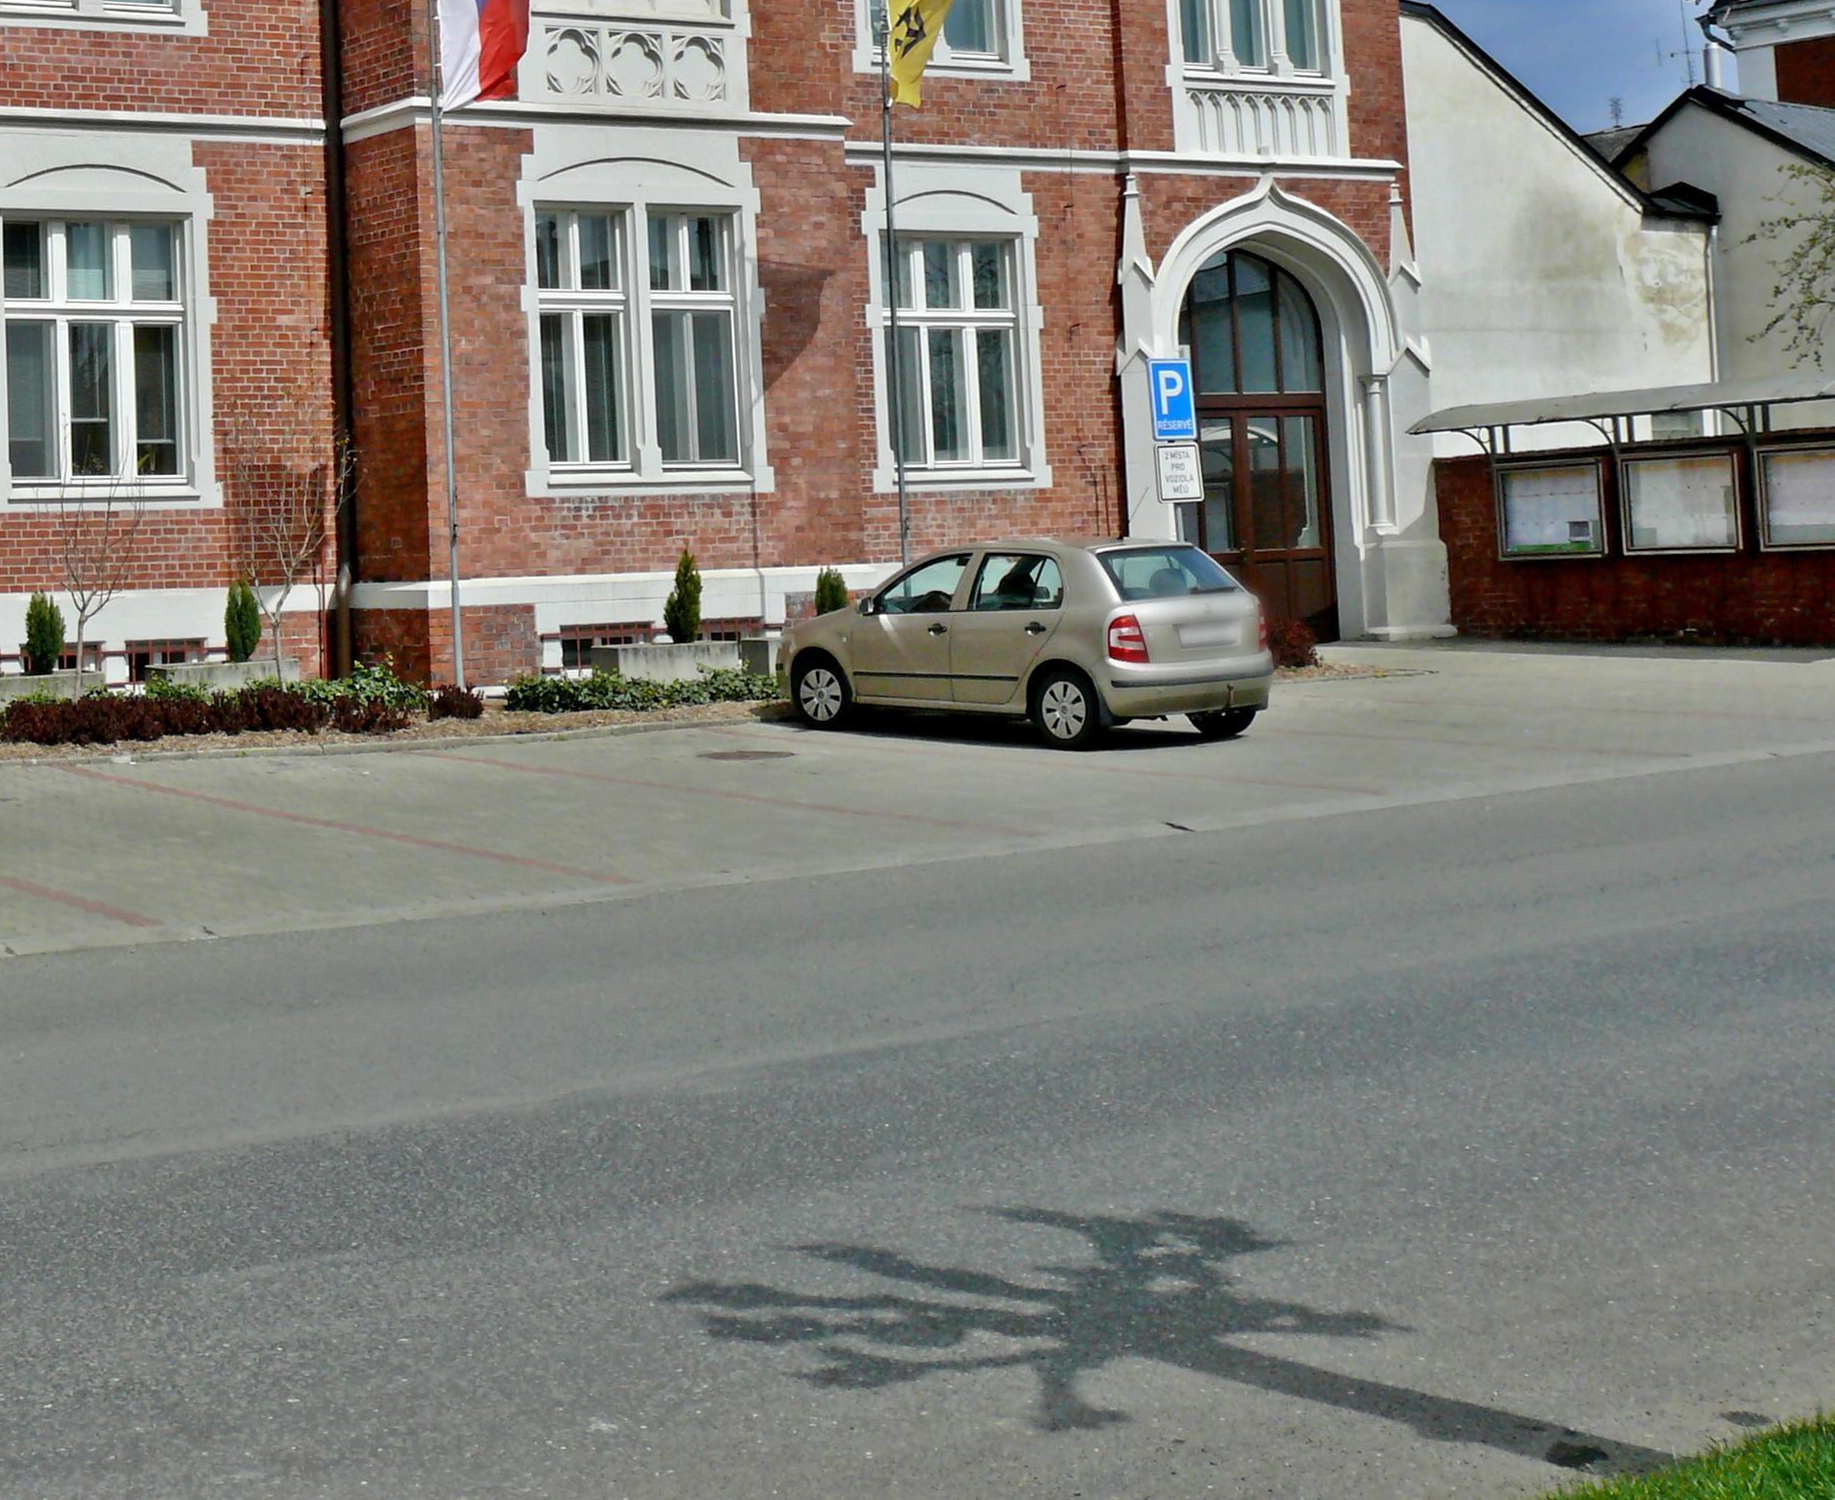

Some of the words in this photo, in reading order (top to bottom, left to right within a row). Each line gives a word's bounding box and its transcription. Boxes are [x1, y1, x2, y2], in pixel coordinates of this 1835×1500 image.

[1158, 370, 1183, 415] P
[1157, 418, 1193, 430] RÉSERVÉ
[1171, 462, 1185, 471] PRO
